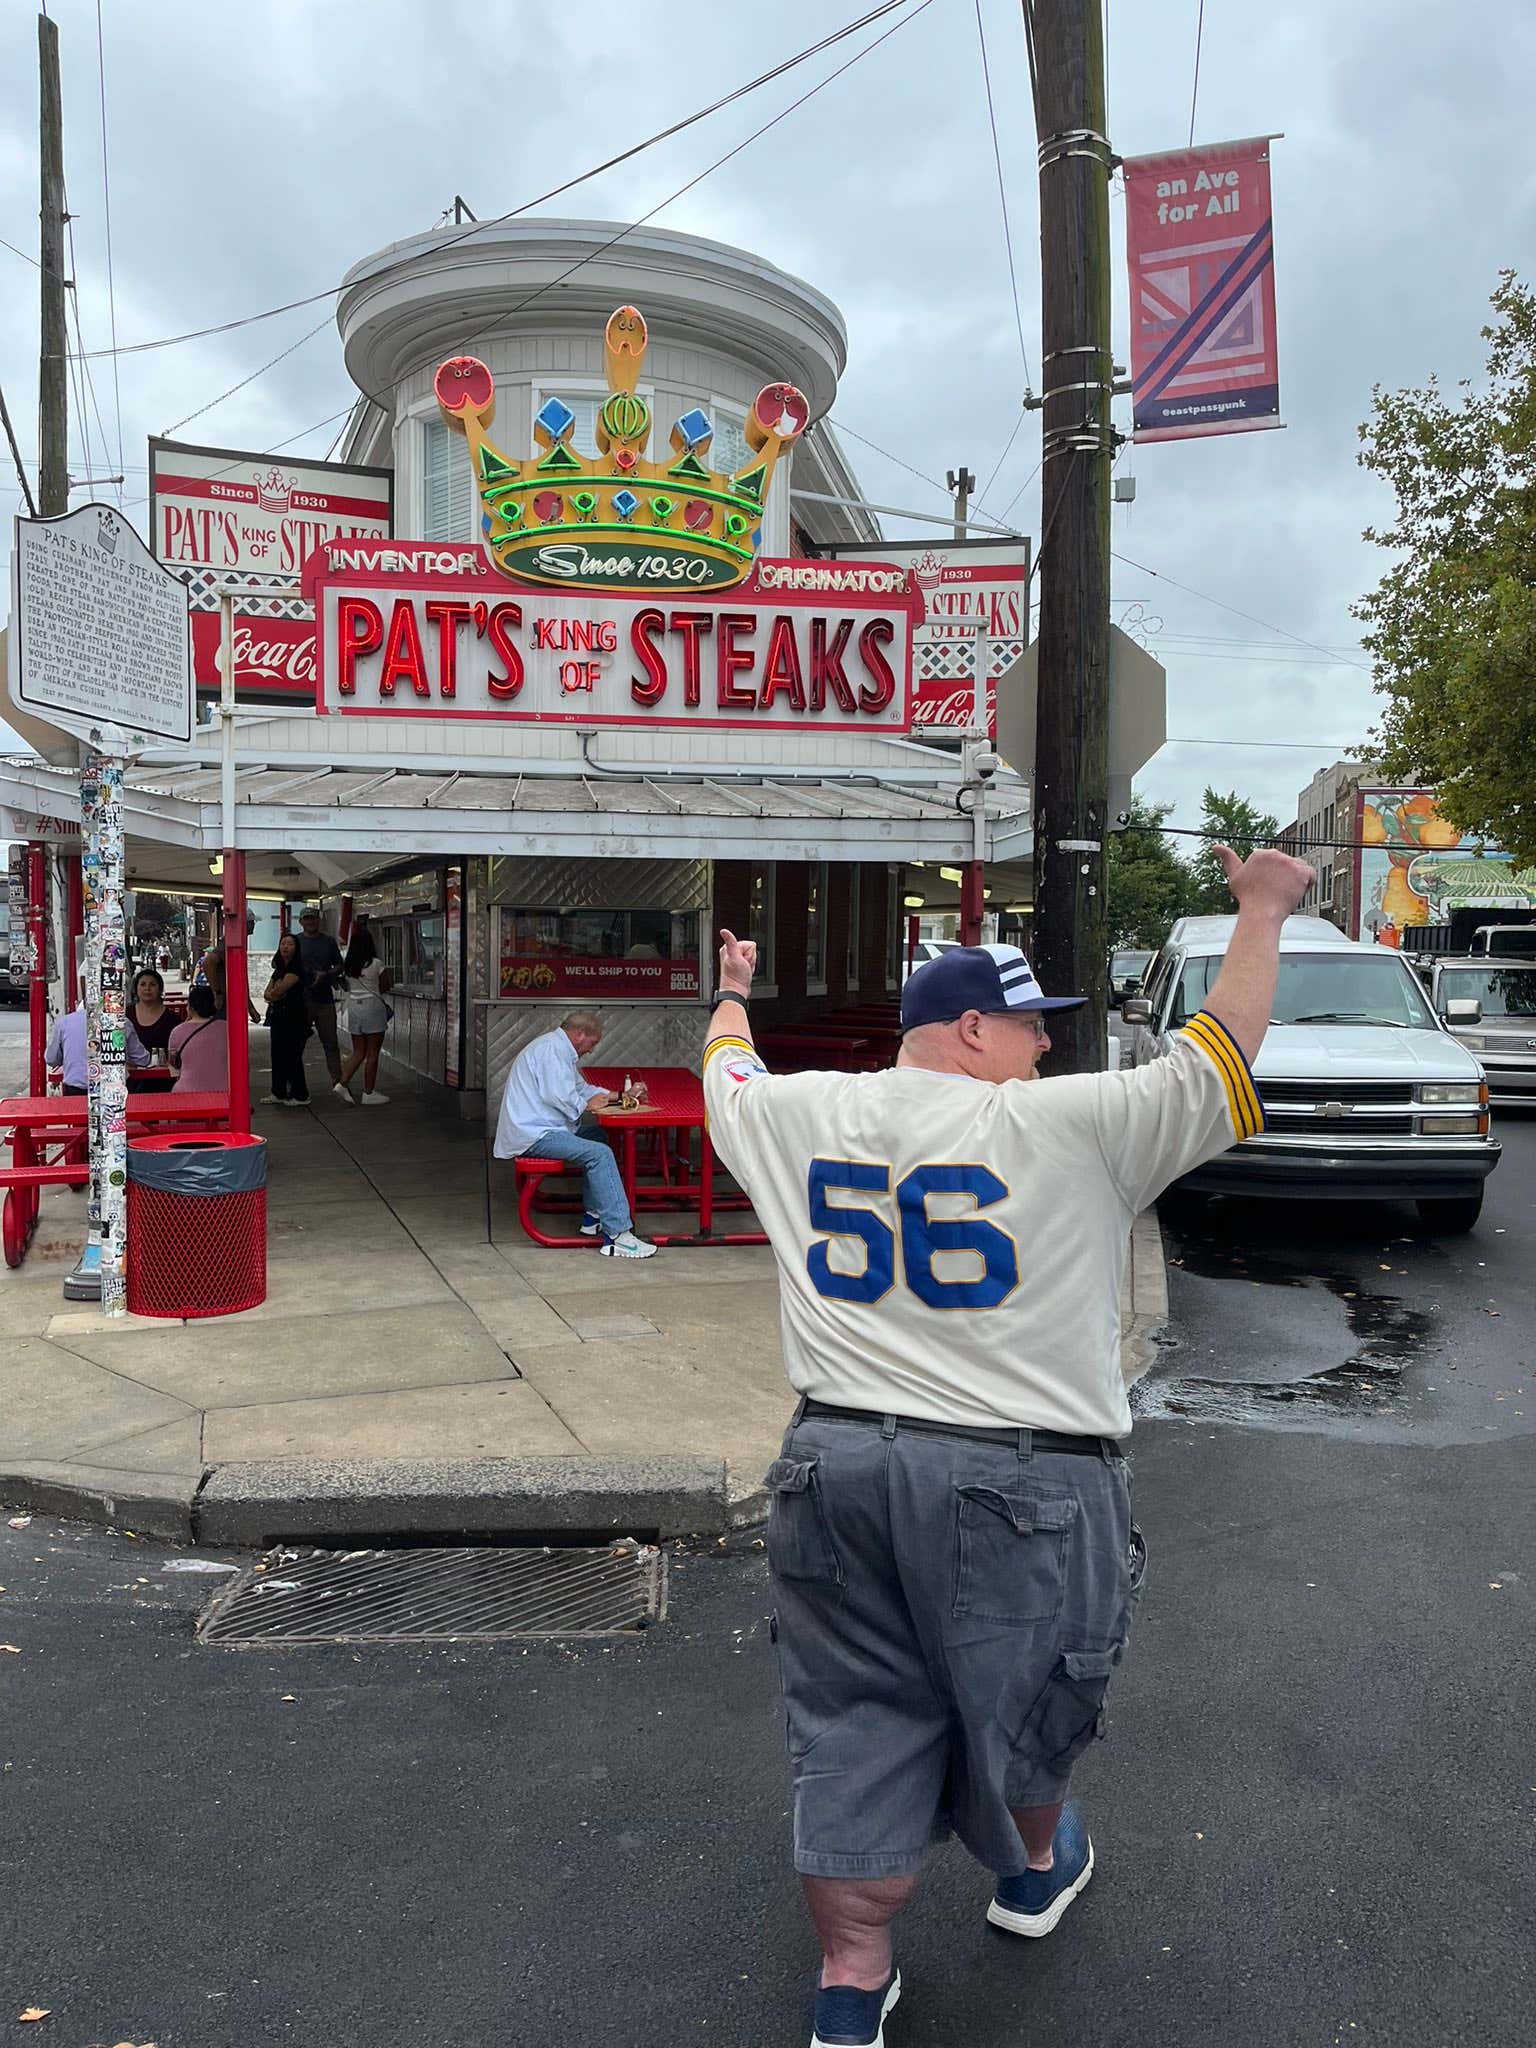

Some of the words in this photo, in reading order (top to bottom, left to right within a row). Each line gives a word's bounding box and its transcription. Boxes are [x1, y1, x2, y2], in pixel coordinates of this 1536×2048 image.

[1156, 179, 1187, 198] an
[1194, 170, 1240, 193] Ave
[1157, 203, 1200, 225] for
[1205, 190, 1240, 217] All
[1162, 399, 1247, 416] @eastpassyunk
[210, 484, 254, 500] Since
[293, 495, 329, 509] 1930
[162, 505, 239, 566] PAT'S
[242, 527, 277, 543] KING
[80, 542, 107, 565] KING
[111, 555, 125, 572] OF
[250, 543, 269, 558] OF
[332, 549, 479, 577] INVENTOR
[536, 544, 632, 578] Since
[636, 555, 708, 583] 1930
[26, 559, 58, 580] CREATED
[61, 573, 76, 586] ONE
[79, 579, 88, 590] OF
[91, 584, 104, 596] THE
[54, 559, 93, 582] BROTHERS
[114, 582, 126, 594] AND
[761, 565, 904, 593] ORIGINATOR
[943, 570, 972, 579] 1930
[26, 592, 54, 610] STEAKS
[55, 602, 95, 623] ORIGINATED
[53, 581, 66, 592] THE
[69, 586, 90, 601] STEAK
[127, 607, 145, 621] FROM
[27, 603, 41, 616] THE
[43, 609, 81, 629] PROTOTYPE
[83, 622, 92, 632] OF
[108, 611, 139, 628] AMERICAN
[27, 625, 47, 639] SINCE
[87, 644, 112, 659] STEAKS
[111, 641, 128, 654] ROLL
[337, 596, 523, 698] PAT'S
[535, 618, 617, 652] KING
[54, 644, 64, 655] TO
[109, 661, 121, 672] AND
[78, 661, 91, 673] AND
[630, 607, 896, 714] STEAKS
[27, 657, 41, 669] THE
[61, 667, 71, 677] OF
[147, 691, 159, 702] THE
[28, 668, 38, 679] OF
[41, 672, 76, 689] AMERICAN
[561, 660, 601, 694] OF
[565, 966, 597, 975] WE'LL
[598, 967, 623, 976] SHIP
[625, 967, 638, 975] TO
[640, 967, 662, 976] YOU
[100, 1052, 126, 1062] COLOR
[806, 1157, 1022, 1310] 56
